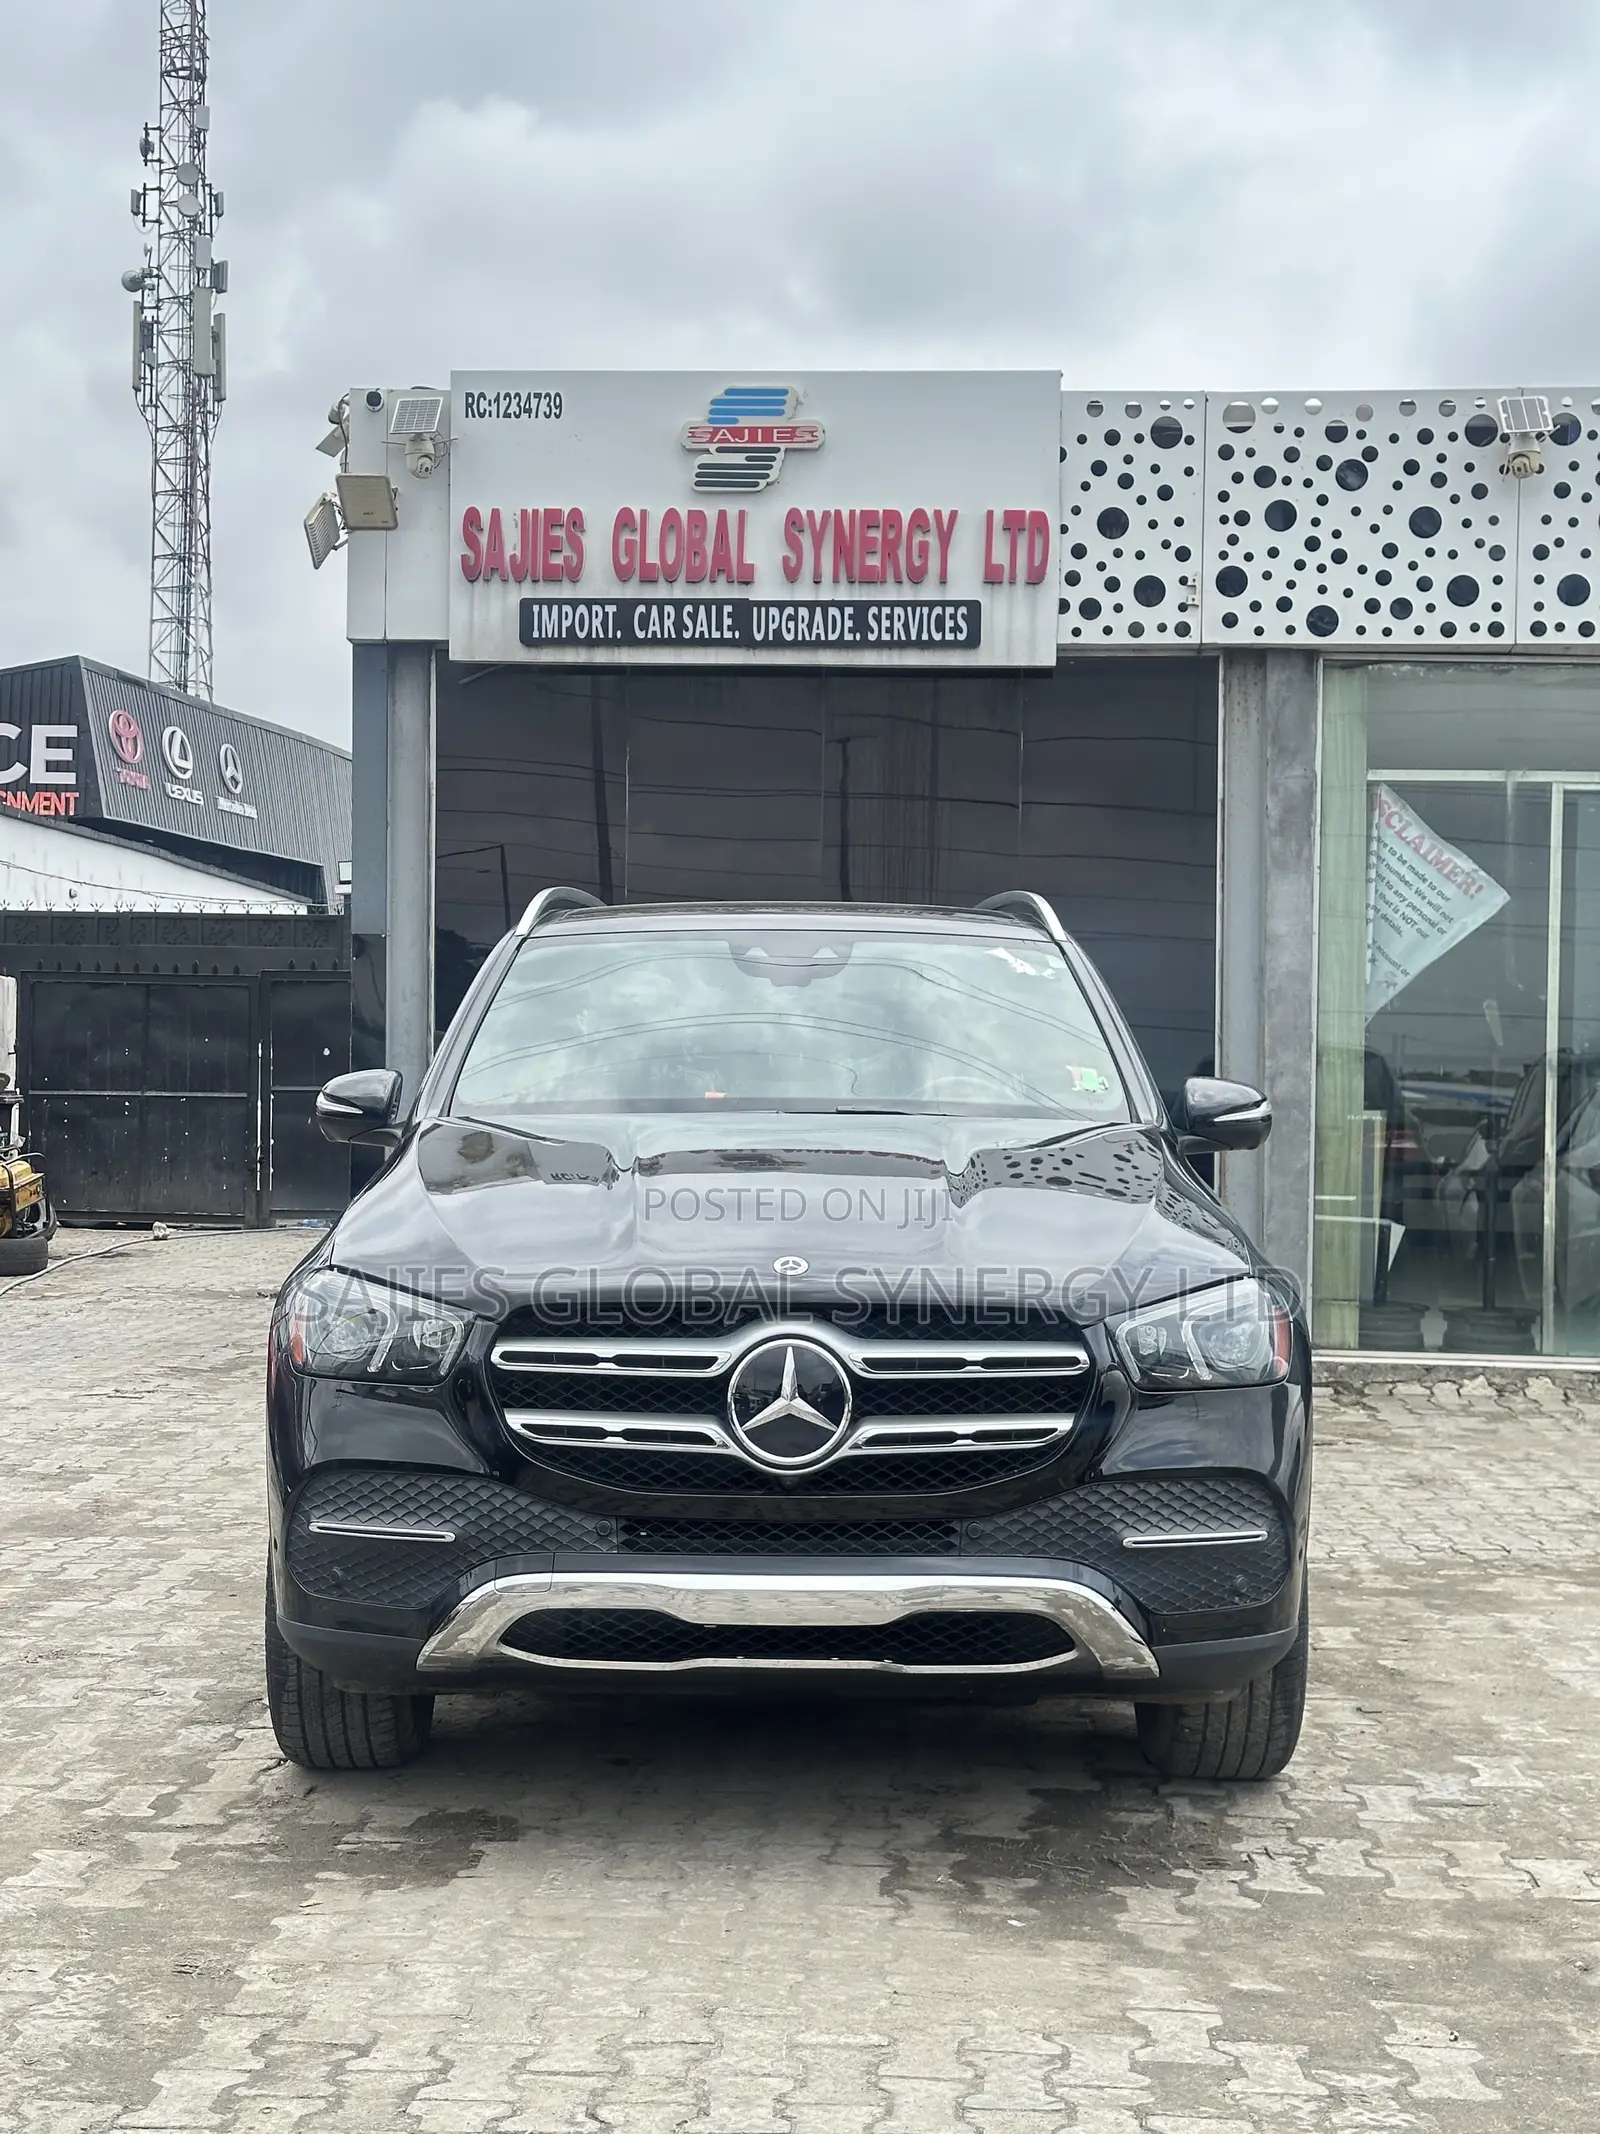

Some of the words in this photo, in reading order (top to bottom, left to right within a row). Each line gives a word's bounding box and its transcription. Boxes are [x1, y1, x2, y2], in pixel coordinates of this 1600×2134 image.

[465, 391, 563, 419] RC:1234739
[690, 425, 818, 445] SAJIES
[460, 506, 586, 584] SAJIES
[611, 506, 755, 584] GLOBAL
[782, 507, 958, 584] SYNERGY
[983, 509, 1050, 585] LTD
[532, 604, 622, 639] IMPORT.
[633, 604, 676, 639] CAR
[682, 604, 740, 639] SALE.
[752, 606, 861, 641] UPGRADE.
[867, 605, 968, 641] SERVICES
[164, 782, 204, 805] LEXUS
[1379, 798, 1484, 900] SCLAIMER!
[1407, 864, 1428, 884] made
[1428, 881, 1437, 891] to
[1437, 890, 1452, 902] our
[1405, 900, 1439, 929] personal
[1427, 898, 1443, 913] will
[1400, 912, 1418, 928] NOT
